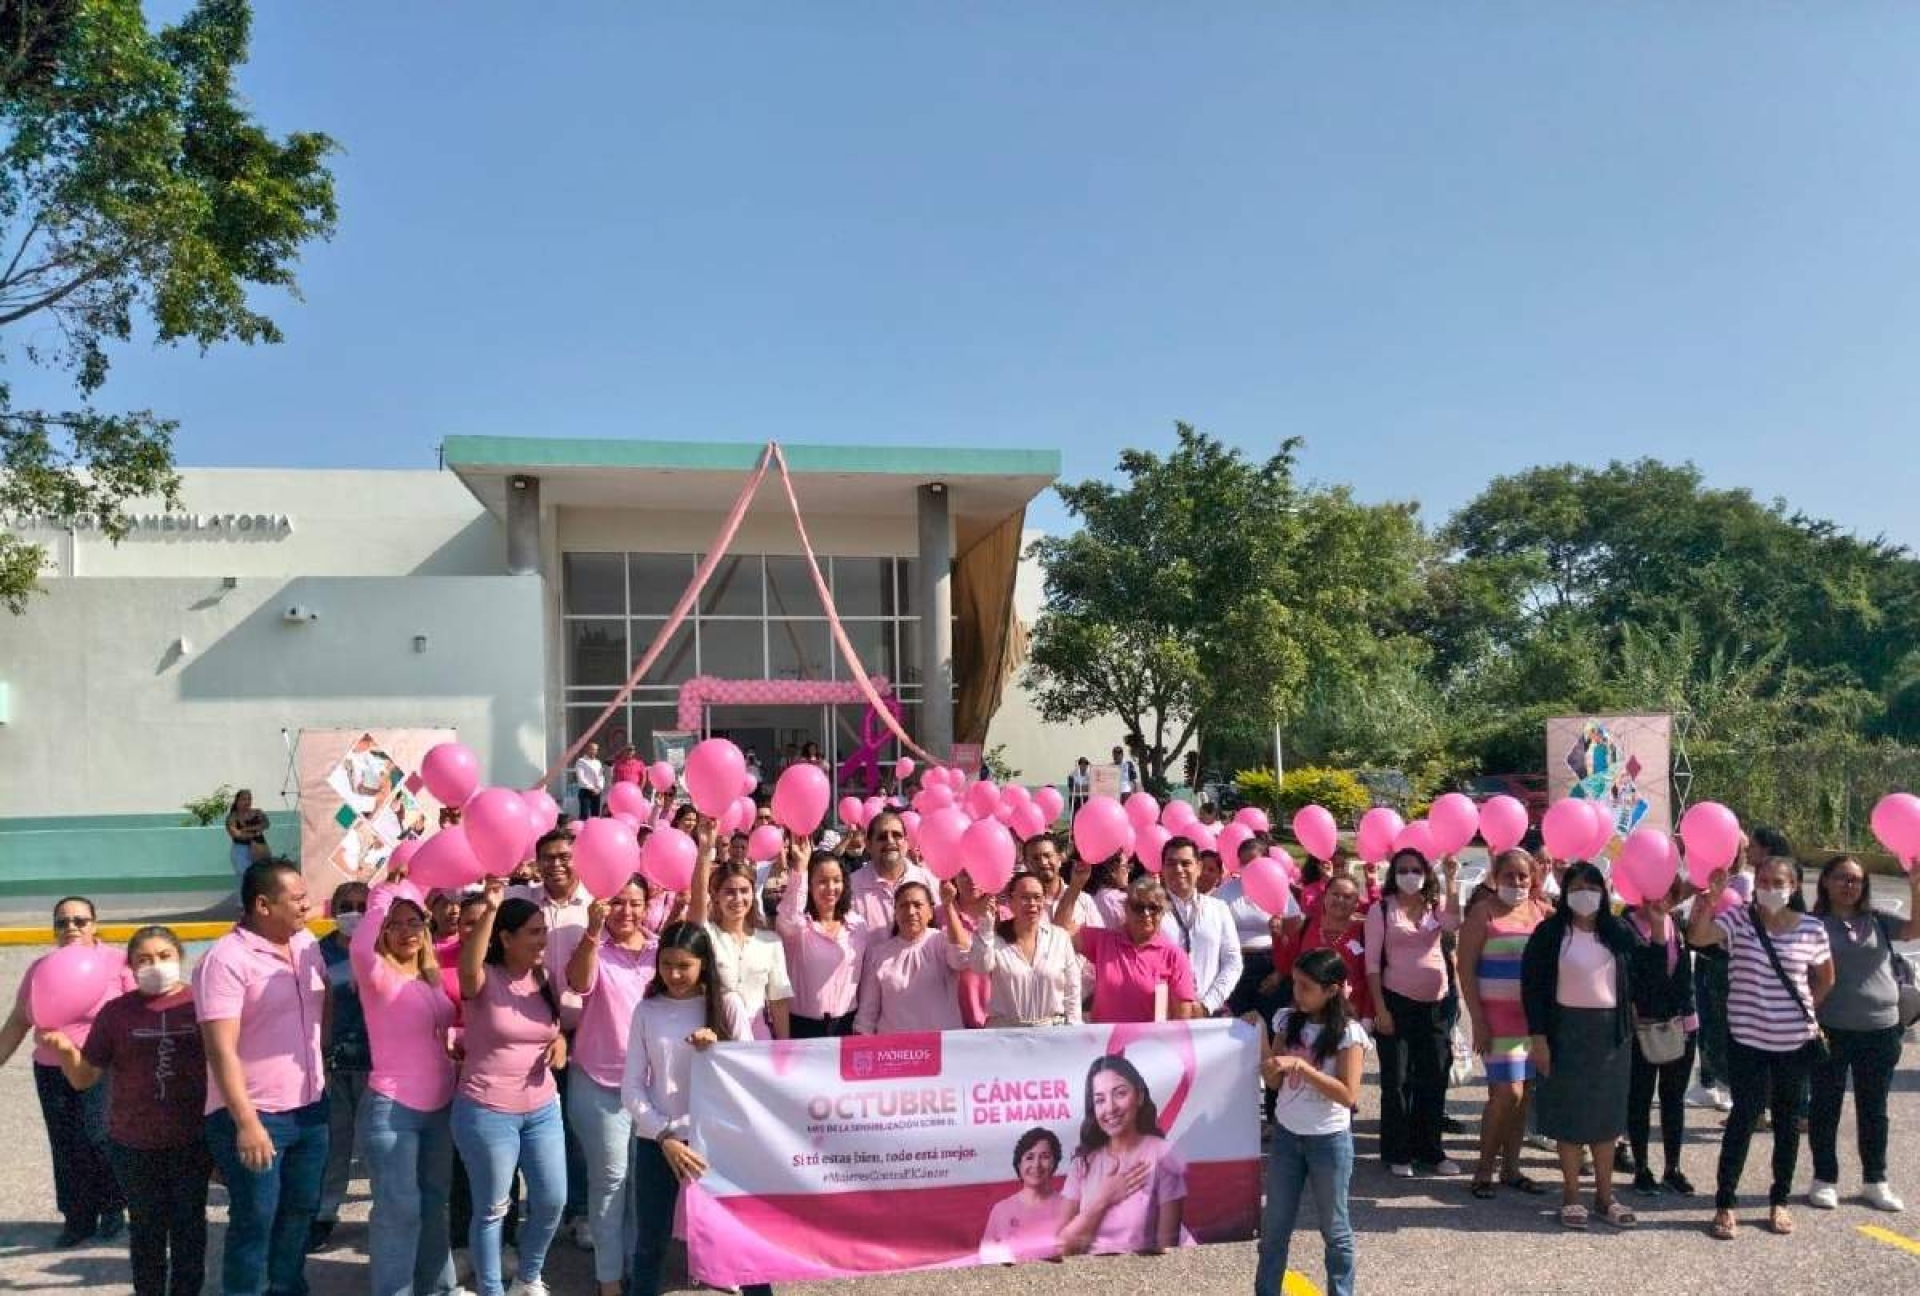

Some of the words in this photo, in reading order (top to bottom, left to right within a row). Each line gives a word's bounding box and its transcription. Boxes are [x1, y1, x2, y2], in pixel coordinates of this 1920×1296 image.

[129, 514, 292, 531] AMBULATORIA
[877, 1049, 931, 1061] MORELOS
[972, 1078, 1070, 1104] CÁNCER
[807, 1088, 957, 1121] OCTUBRE
[973, 1106, 1001, 1125] DE
[1005, 1104, 1071, 1122] MAMA
[806, 1151, 820, 1165] tú
[853, 1151, 884, 1164] bien,
[886, 1149, 913, 1163] todo
[914, 1147, 937, 1161] está
[940, 1145, 978, 1162] mejor.
